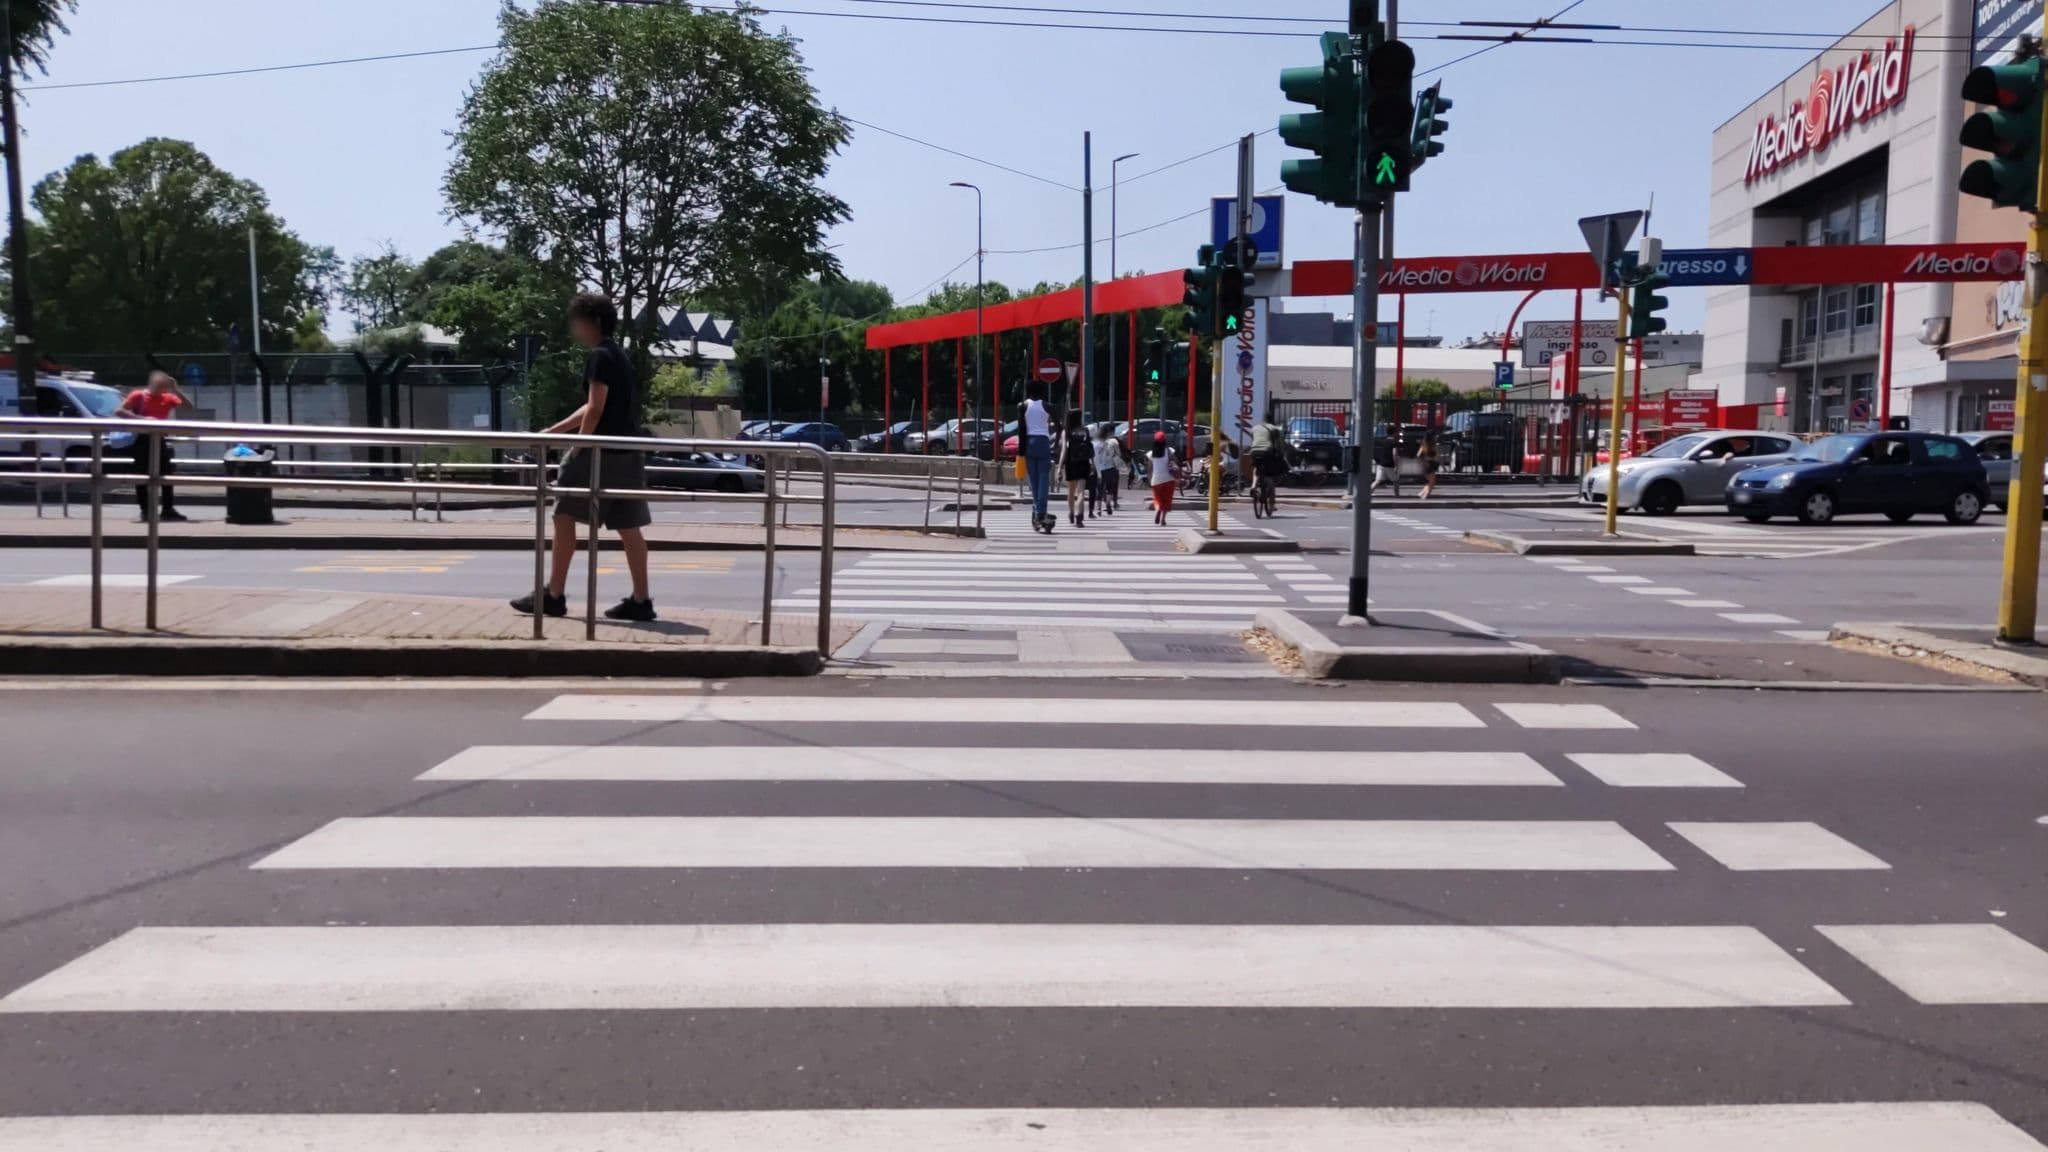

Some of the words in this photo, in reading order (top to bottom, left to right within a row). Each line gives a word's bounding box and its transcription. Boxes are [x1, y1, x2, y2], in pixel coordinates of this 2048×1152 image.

[1744, 101, 1807, 179] Media
[1828, 31, 1908, 132] World
[1905, 252, 1990, 273] Media
[1378, 265, 1452, 286] Media
[1480, 262, 1547, 282] World
[1547, 339, 1599, 352] ingrsso
[1499, 366, 1510, 380] P
[1236, 377, 1254, 440] Media
